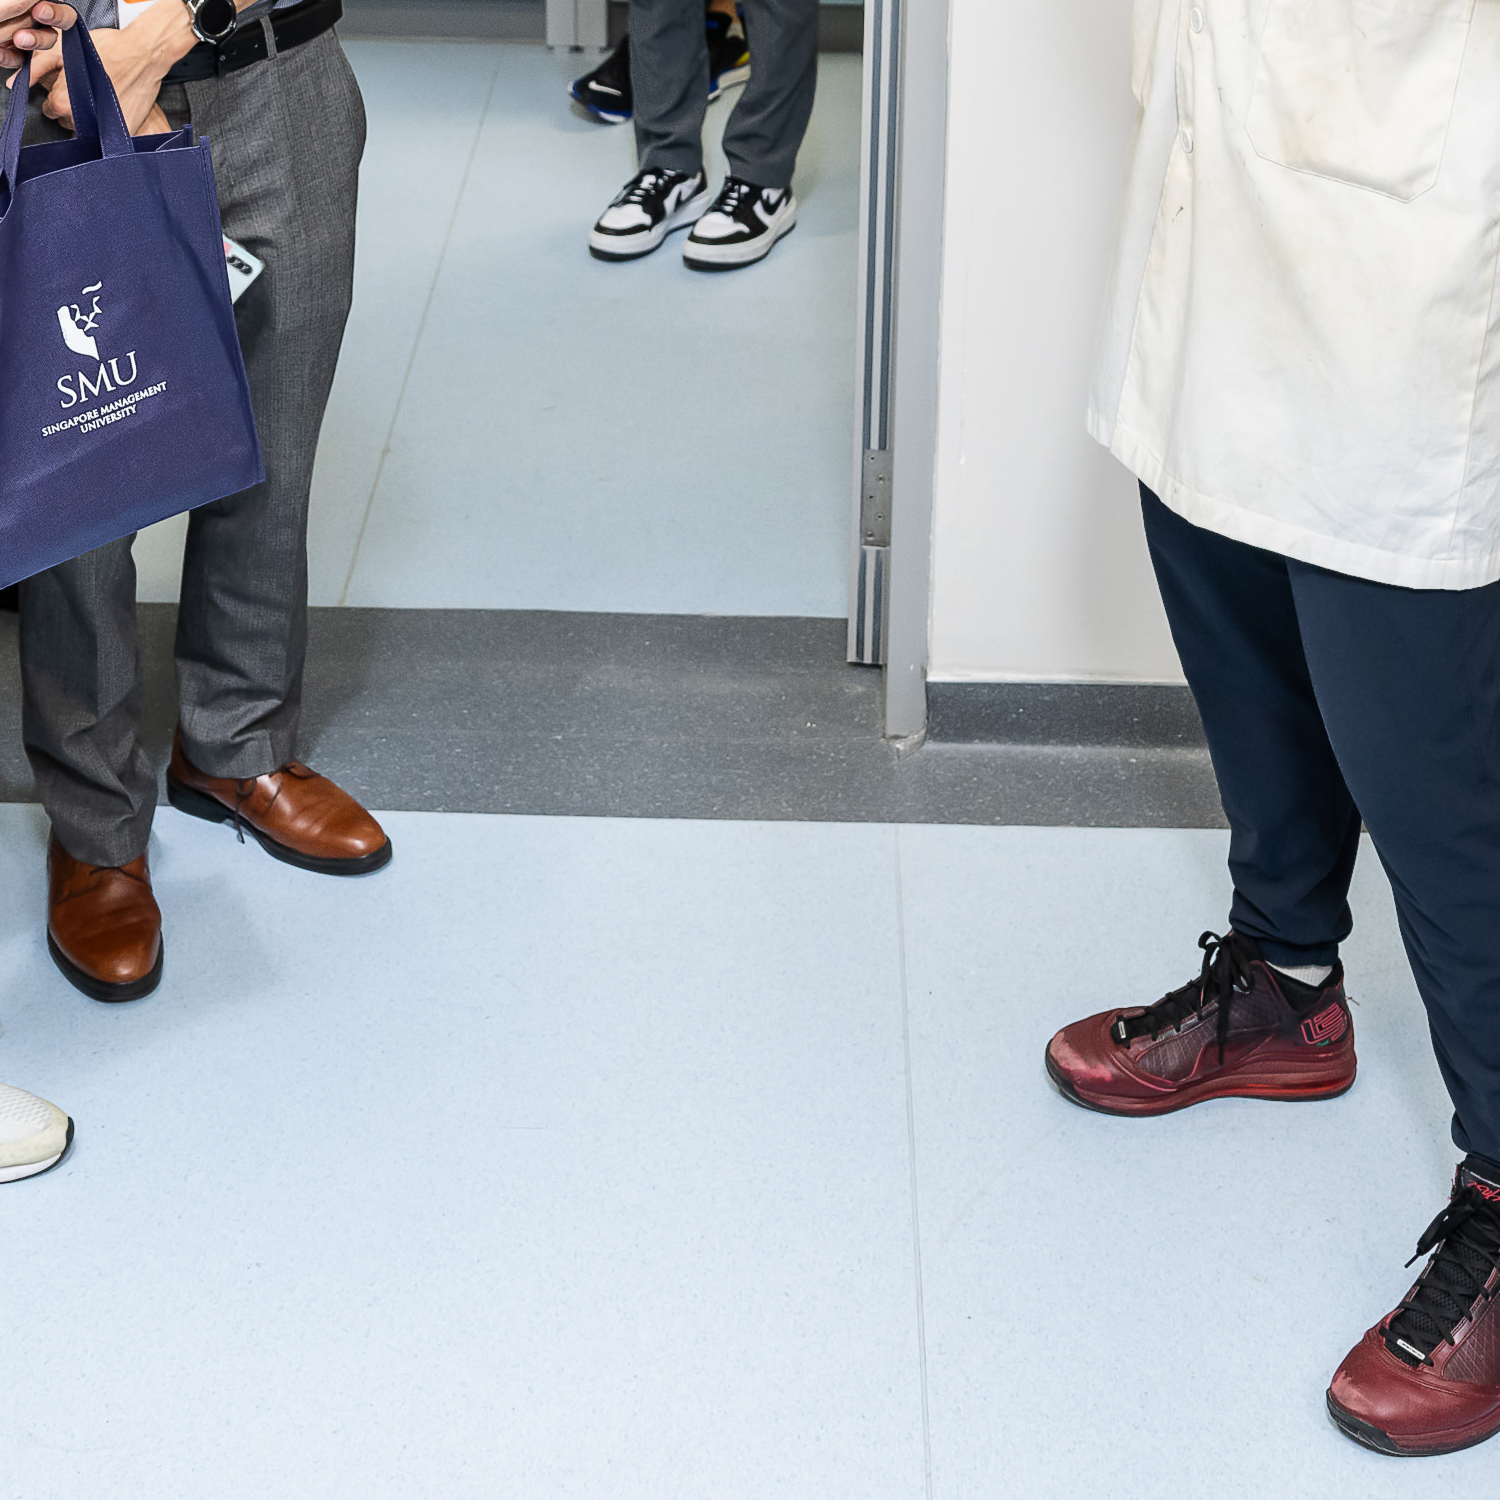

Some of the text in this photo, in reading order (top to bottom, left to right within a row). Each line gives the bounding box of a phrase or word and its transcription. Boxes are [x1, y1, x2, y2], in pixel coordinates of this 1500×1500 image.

[56, 350, 138, 409] SMU
[41, 380, 167, 438] SINGAPORE MANAGEMENT
[80, 404, 137, 434] UNIVERSITY
